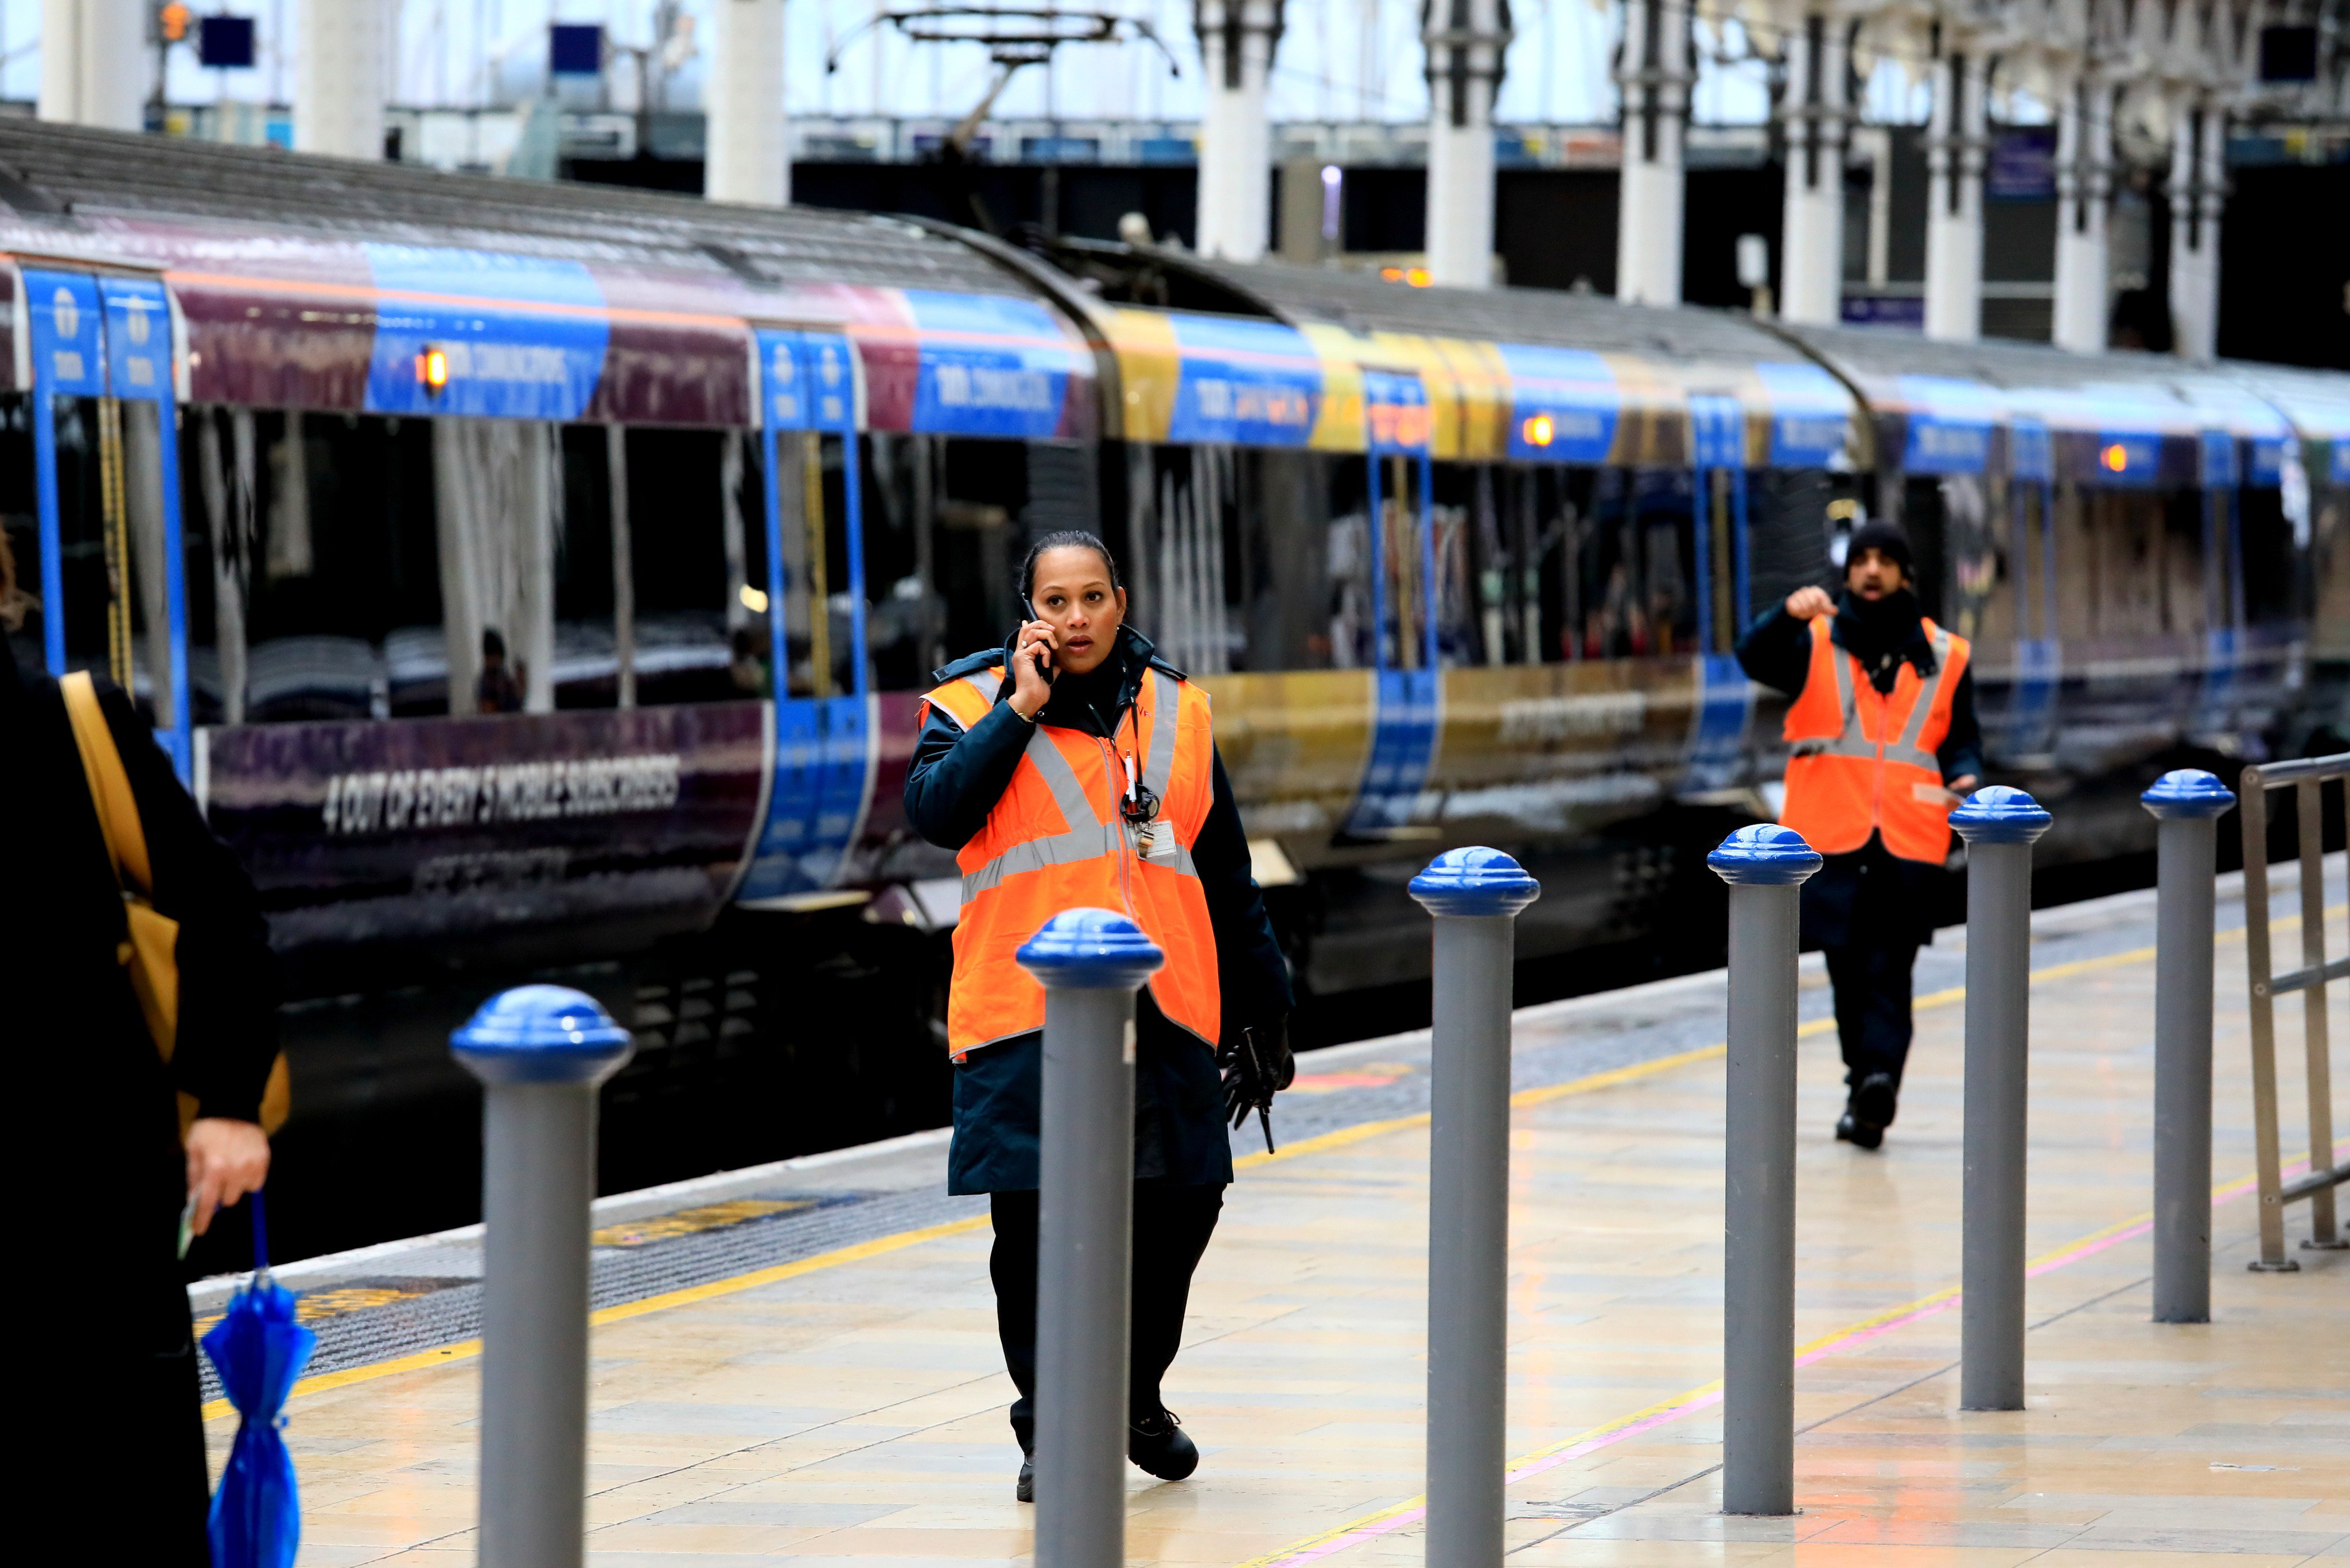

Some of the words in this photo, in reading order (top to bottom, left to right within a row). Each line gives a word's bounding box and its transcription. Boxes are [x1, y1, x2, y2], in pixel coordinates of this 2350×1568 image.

[342, 771, 387, 832] OUT
[387, 769, 418, 830] OF
[415, 767, 481, 827] EVERY
